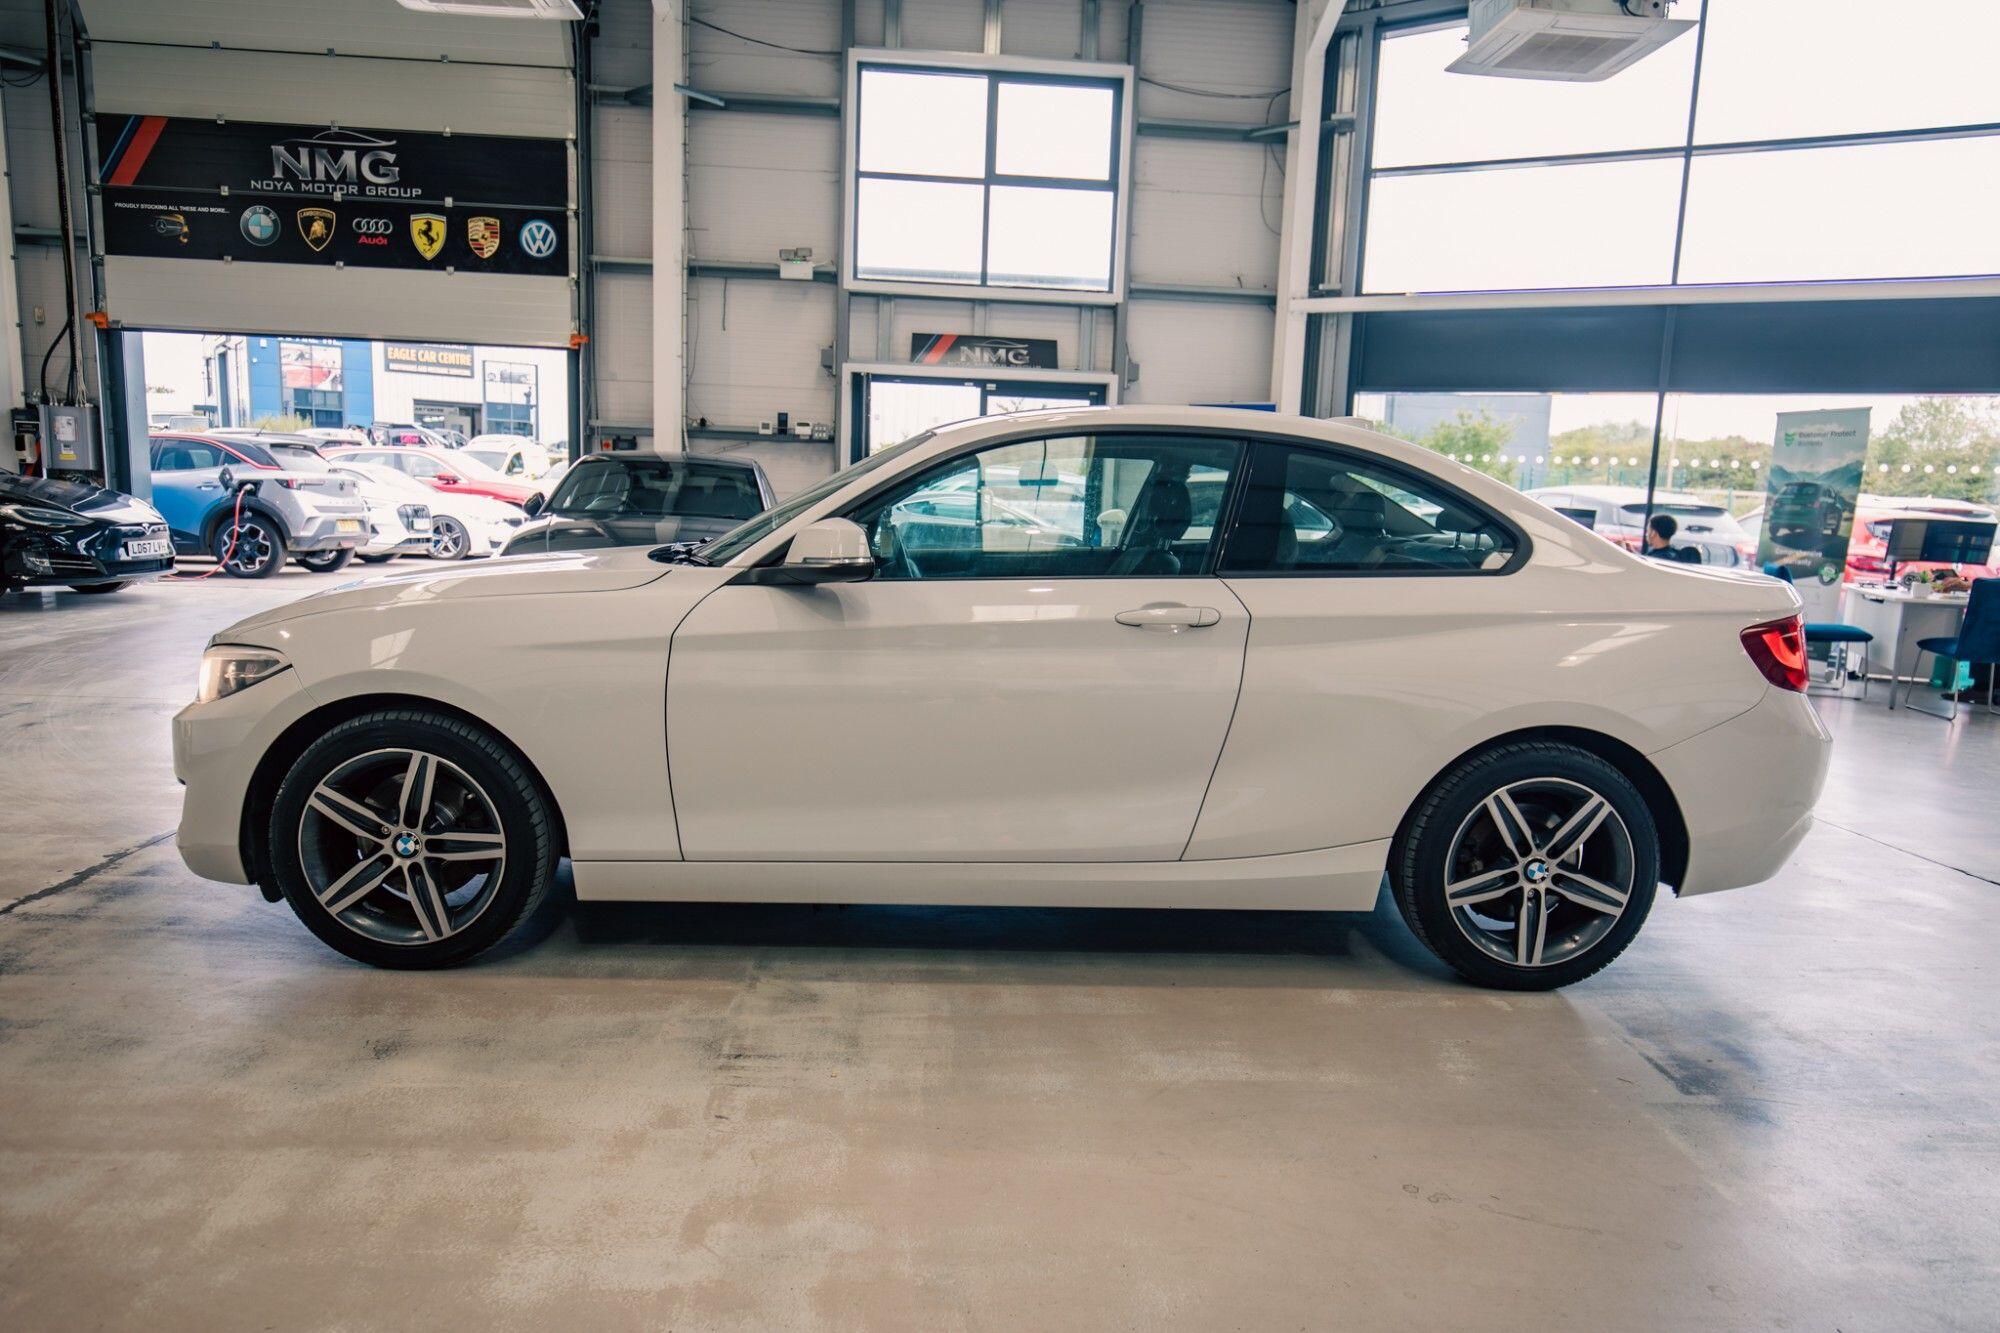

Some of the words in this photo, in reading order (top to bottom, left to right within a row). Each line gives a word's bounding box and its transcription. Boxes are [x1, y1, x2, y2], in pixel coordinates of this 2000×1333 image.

[271, 145, 400, 184] NMG
[250, 180, 294, 191] NOYA
[301, 183, 358, 195] MOTOR
[366, 186, 422, 197] GROUP
[358, 235, 388, 245] Audi
[388, 347, 417, 361] EAGLE
[417, 350, 437, 363] CAR
[438, 352, 471, 366] CENTRE
[960, 346, 1030, 364] NMG
[1830, 430, 1857, 438] Protect
